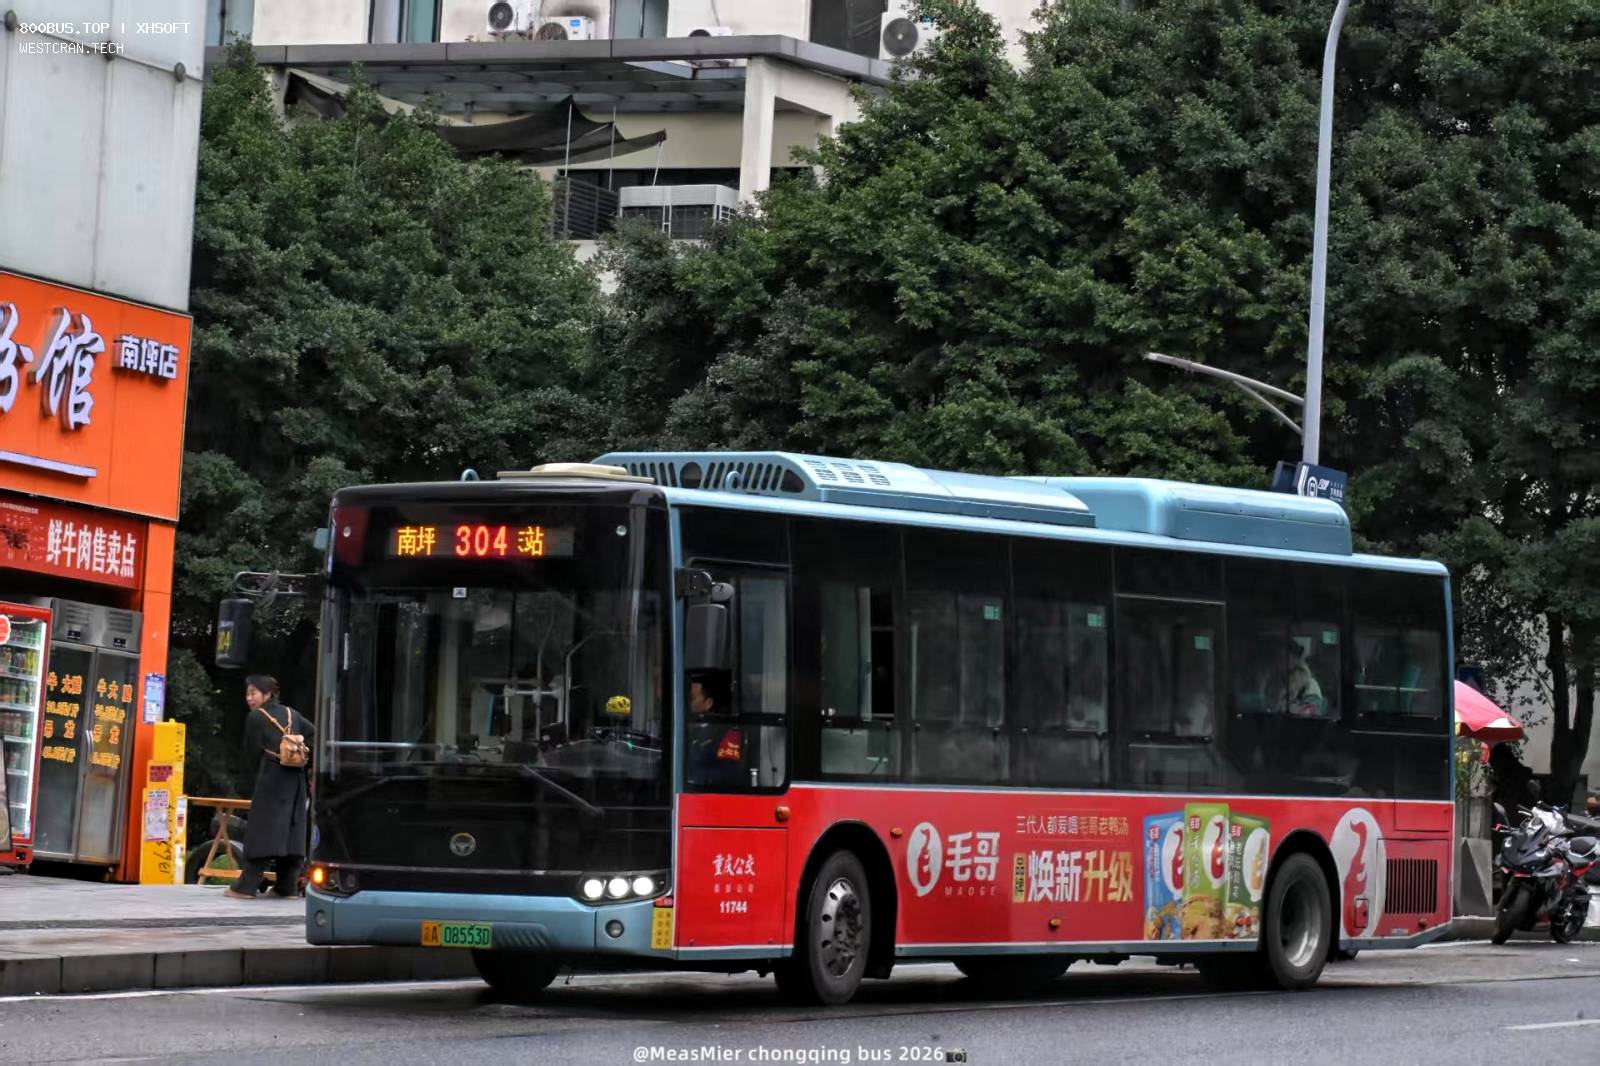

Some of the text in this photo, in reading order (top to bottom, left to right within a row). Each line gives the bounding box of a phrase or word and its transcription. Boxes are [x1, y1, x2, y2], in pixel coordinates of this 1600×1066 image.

[119, 334, 179, 379] 南坪店
[46, 519, 137, 578] 鲜牛肉售卖点
[397, 526, 436, 556] 南坪
[456, 525, 508, 556] 304
[945, 832, 1000, 881] 毛哥
[1028, 850, 1134, 903] 焕新升级
[719, 901, 748, 914] 11744
[945, 886, 997, 897] MAOGE
